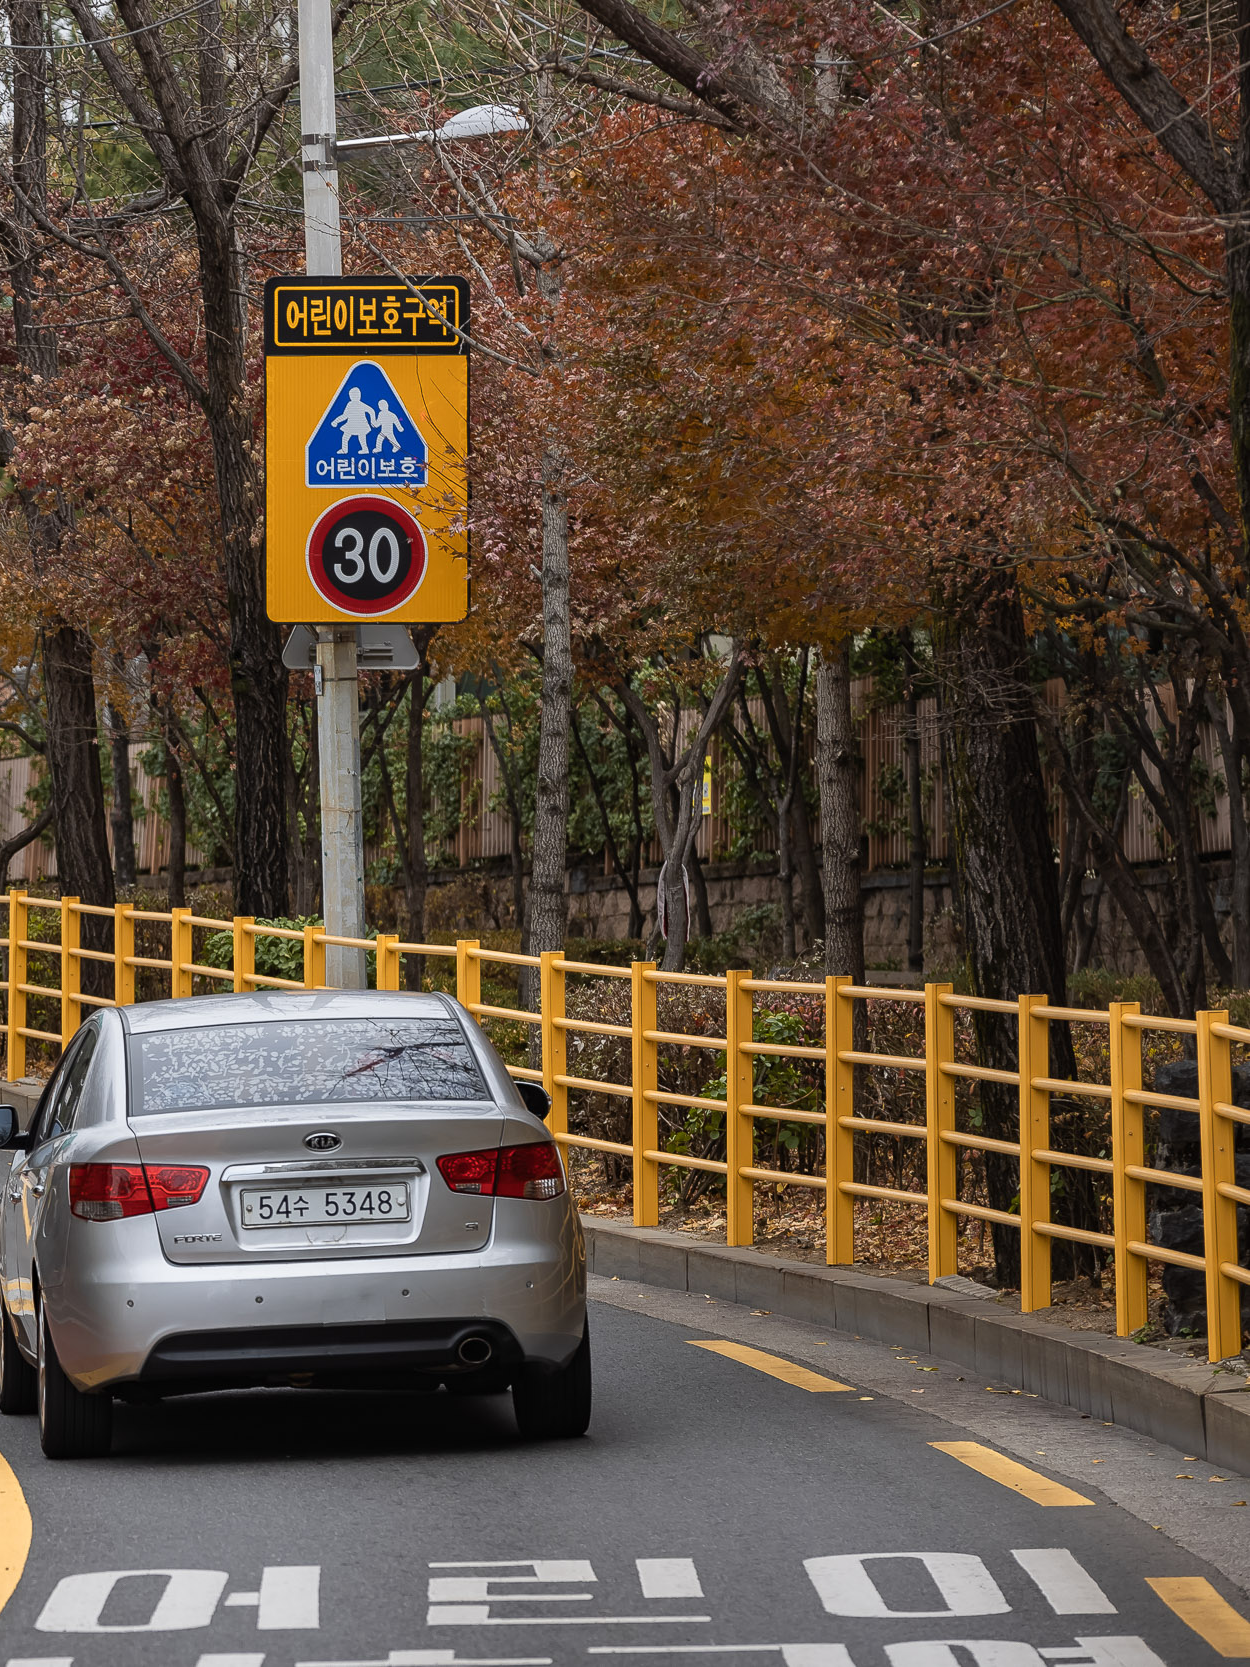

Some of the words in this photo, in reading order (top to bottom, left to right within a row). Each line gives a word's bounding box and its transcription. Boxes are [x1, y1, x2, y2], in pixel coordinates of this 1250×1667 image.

[286, 295, 448, 337] 어린이보호구역
[315, 457, 419, 480] 어린이보호
[333, 527, 400, 584] 30
[311, 1136, 335, 1149] KIA
[259, 1195, 310, 1220] 54수
[324, 1190, 393, 1217] 5348
[174, 1233, 223, 1245] FORTE
